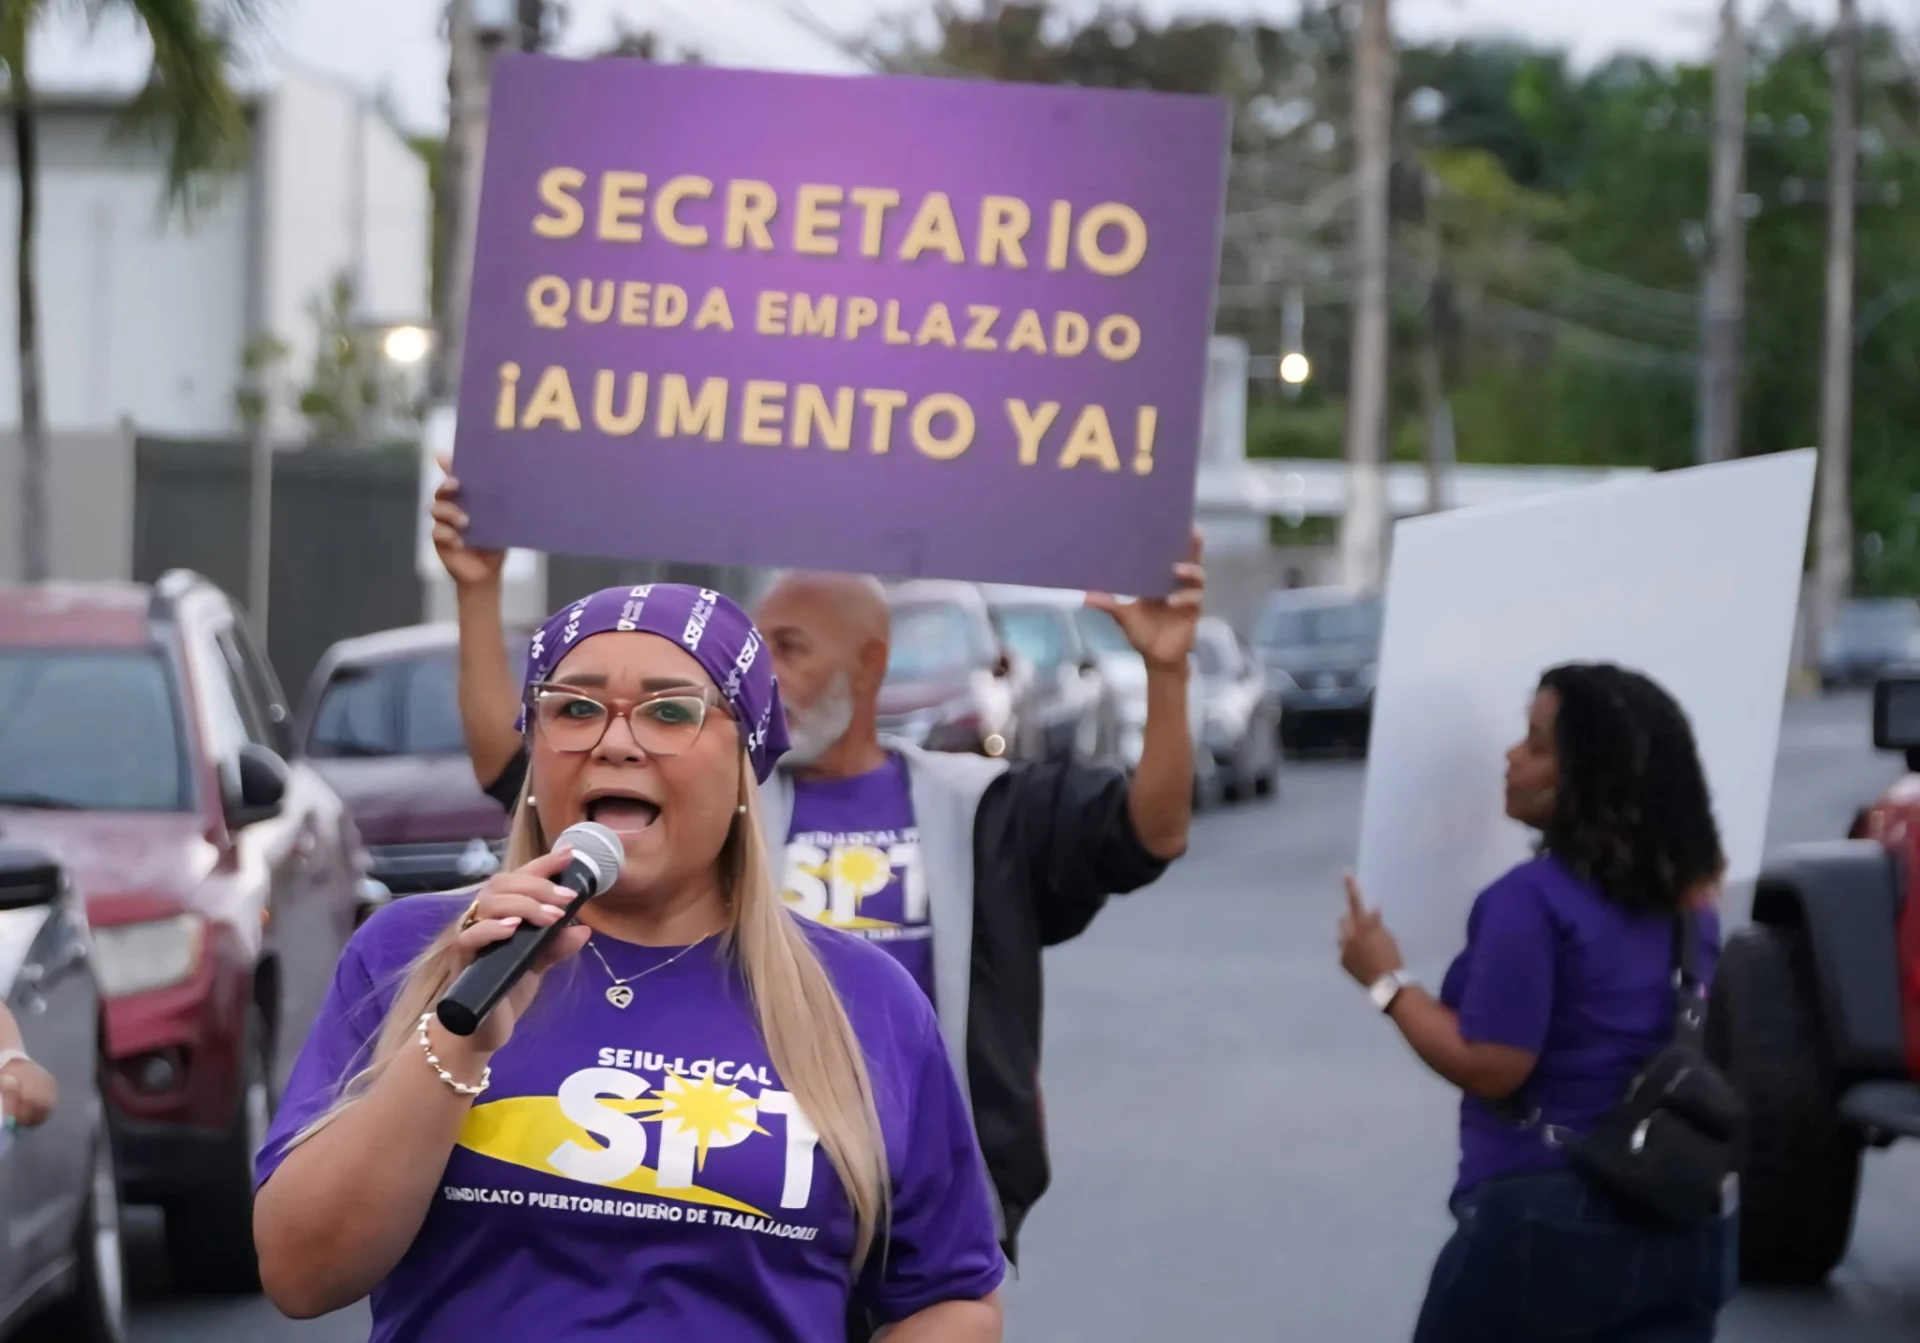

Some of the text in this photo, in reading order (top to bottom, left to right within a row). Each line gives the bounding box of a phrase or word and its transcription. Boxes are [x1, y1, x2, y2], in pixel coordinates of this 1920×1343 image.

[532, 166, 1149, 276] SECRETARIO
[526, 274, 1142, 361] QUEDA EMPLAZADO
[495, 361, 1159, 475] ¡AUMENTO YA!
[546, 1067, 820, 1210] SPT
[444, 1186, 525, 1206] SINDICATO
[528, 1191, 682, 1222] PUERTORRIQUEÑO
[686, 1208, 708, 1224] DE
